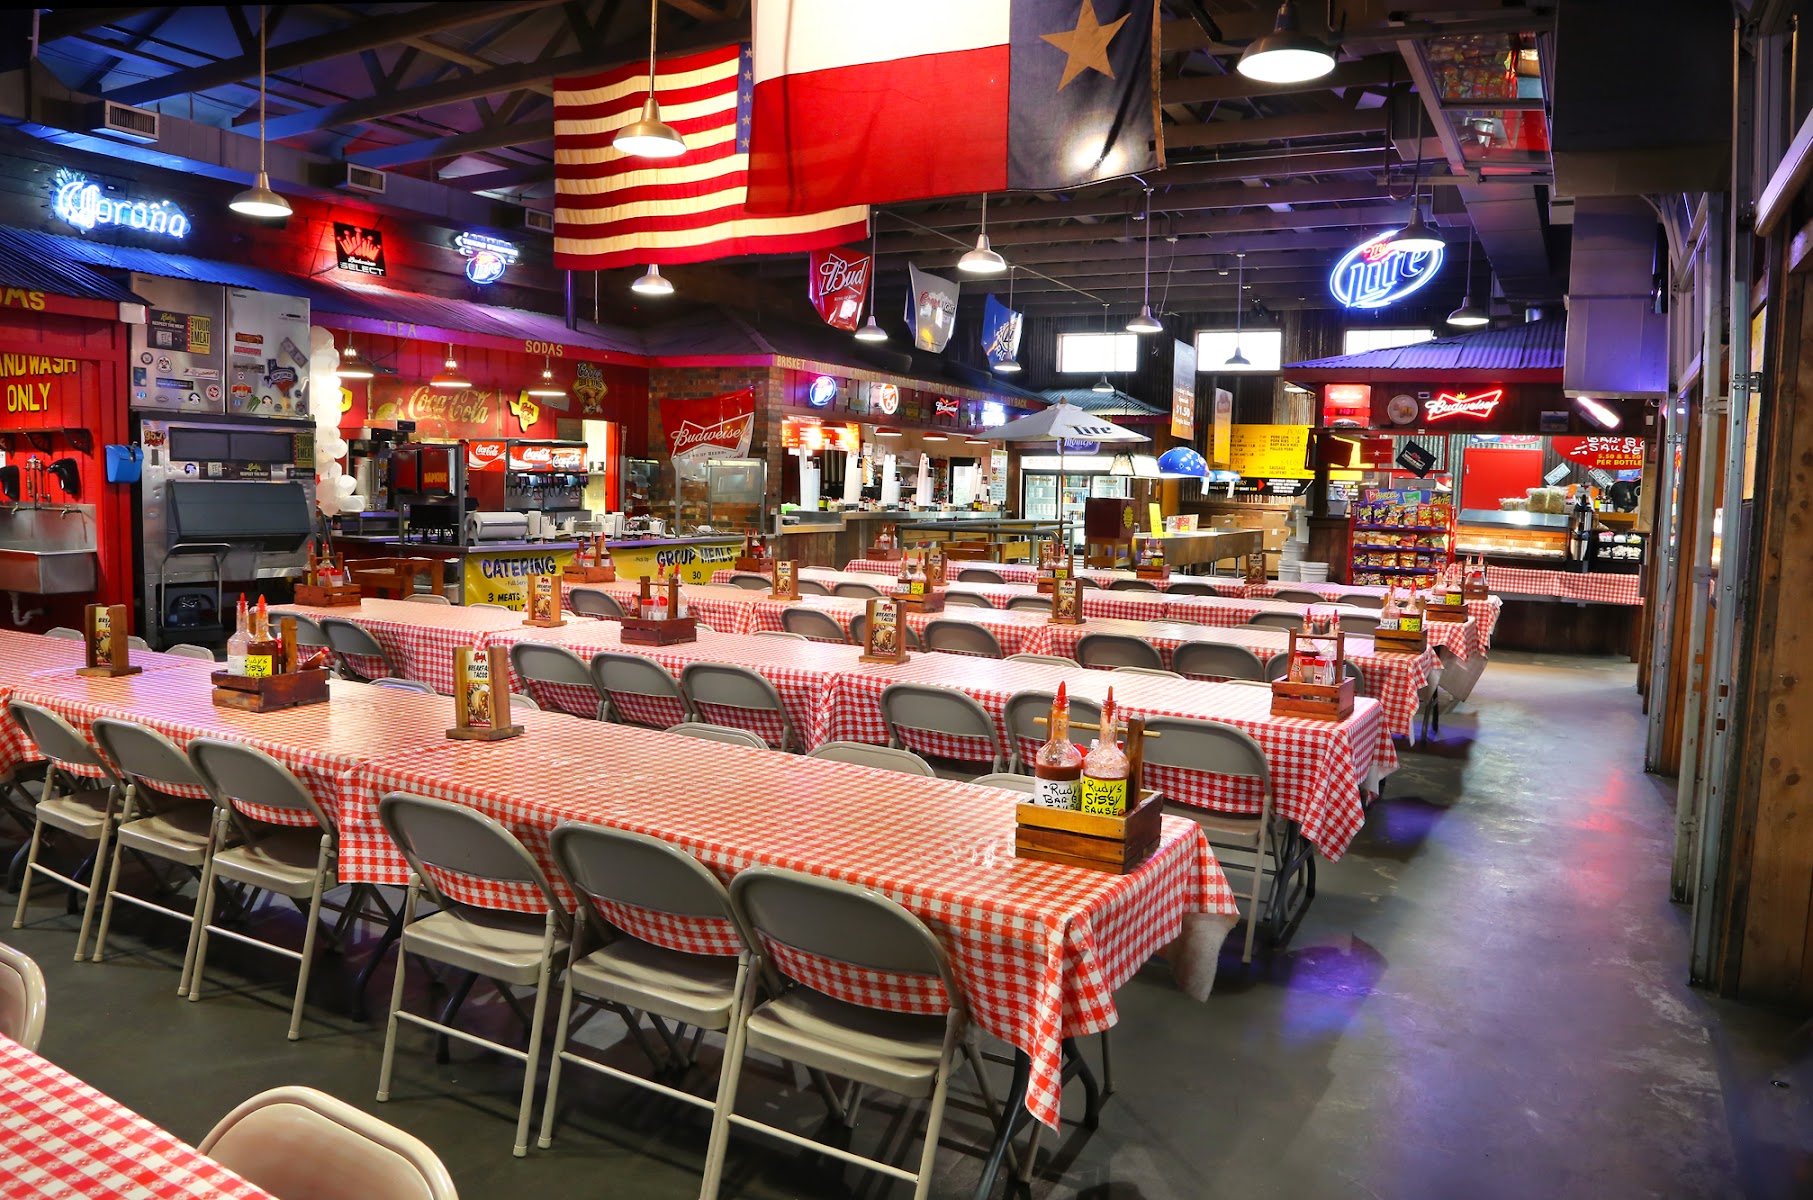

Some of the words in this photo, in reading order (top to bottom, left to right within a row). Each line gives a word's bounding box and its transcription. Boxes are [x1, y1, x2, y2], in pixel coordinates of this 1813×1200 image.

[339, 261, 385, 277] SELECT
[820, 260, 864, 293] Bud
[0, 287, 46, 311] MS
[384, 321, 418, 338] TEA
[525, 340, 564, 357] SODAS
[777, 355, 806, 370] BRISKET
[927, 382, 943, 394] PORK
[1014, 398, 1028, 408] BACK
[6, 382, 51, 413] ONLY
[1425, 399, 1499, 416] Budweiser
[1072, 425, 1113, 437] Lite
[423, 471, 448, 484] NAPKINS
[655, 548, 697, 567] GROUP
[700, 546, 733, 564] MEALS
[481, 555, 556, 580] CATERING
[692, 570, 702, 580] 30
[487, 592, 494, 602] 3
[497, 592, 521, 602] MEATS
[467, 664, 489, 672] BREAKFA
[473, 670, 488, 679] TACOS
[1049, 782, 1080, 796] Rudy'
[1087, 780, 1122, 798] Rudy's
[1085, 792, 1122, 809] Sissy
[1084, 805, 1118, 817] SAUSE
